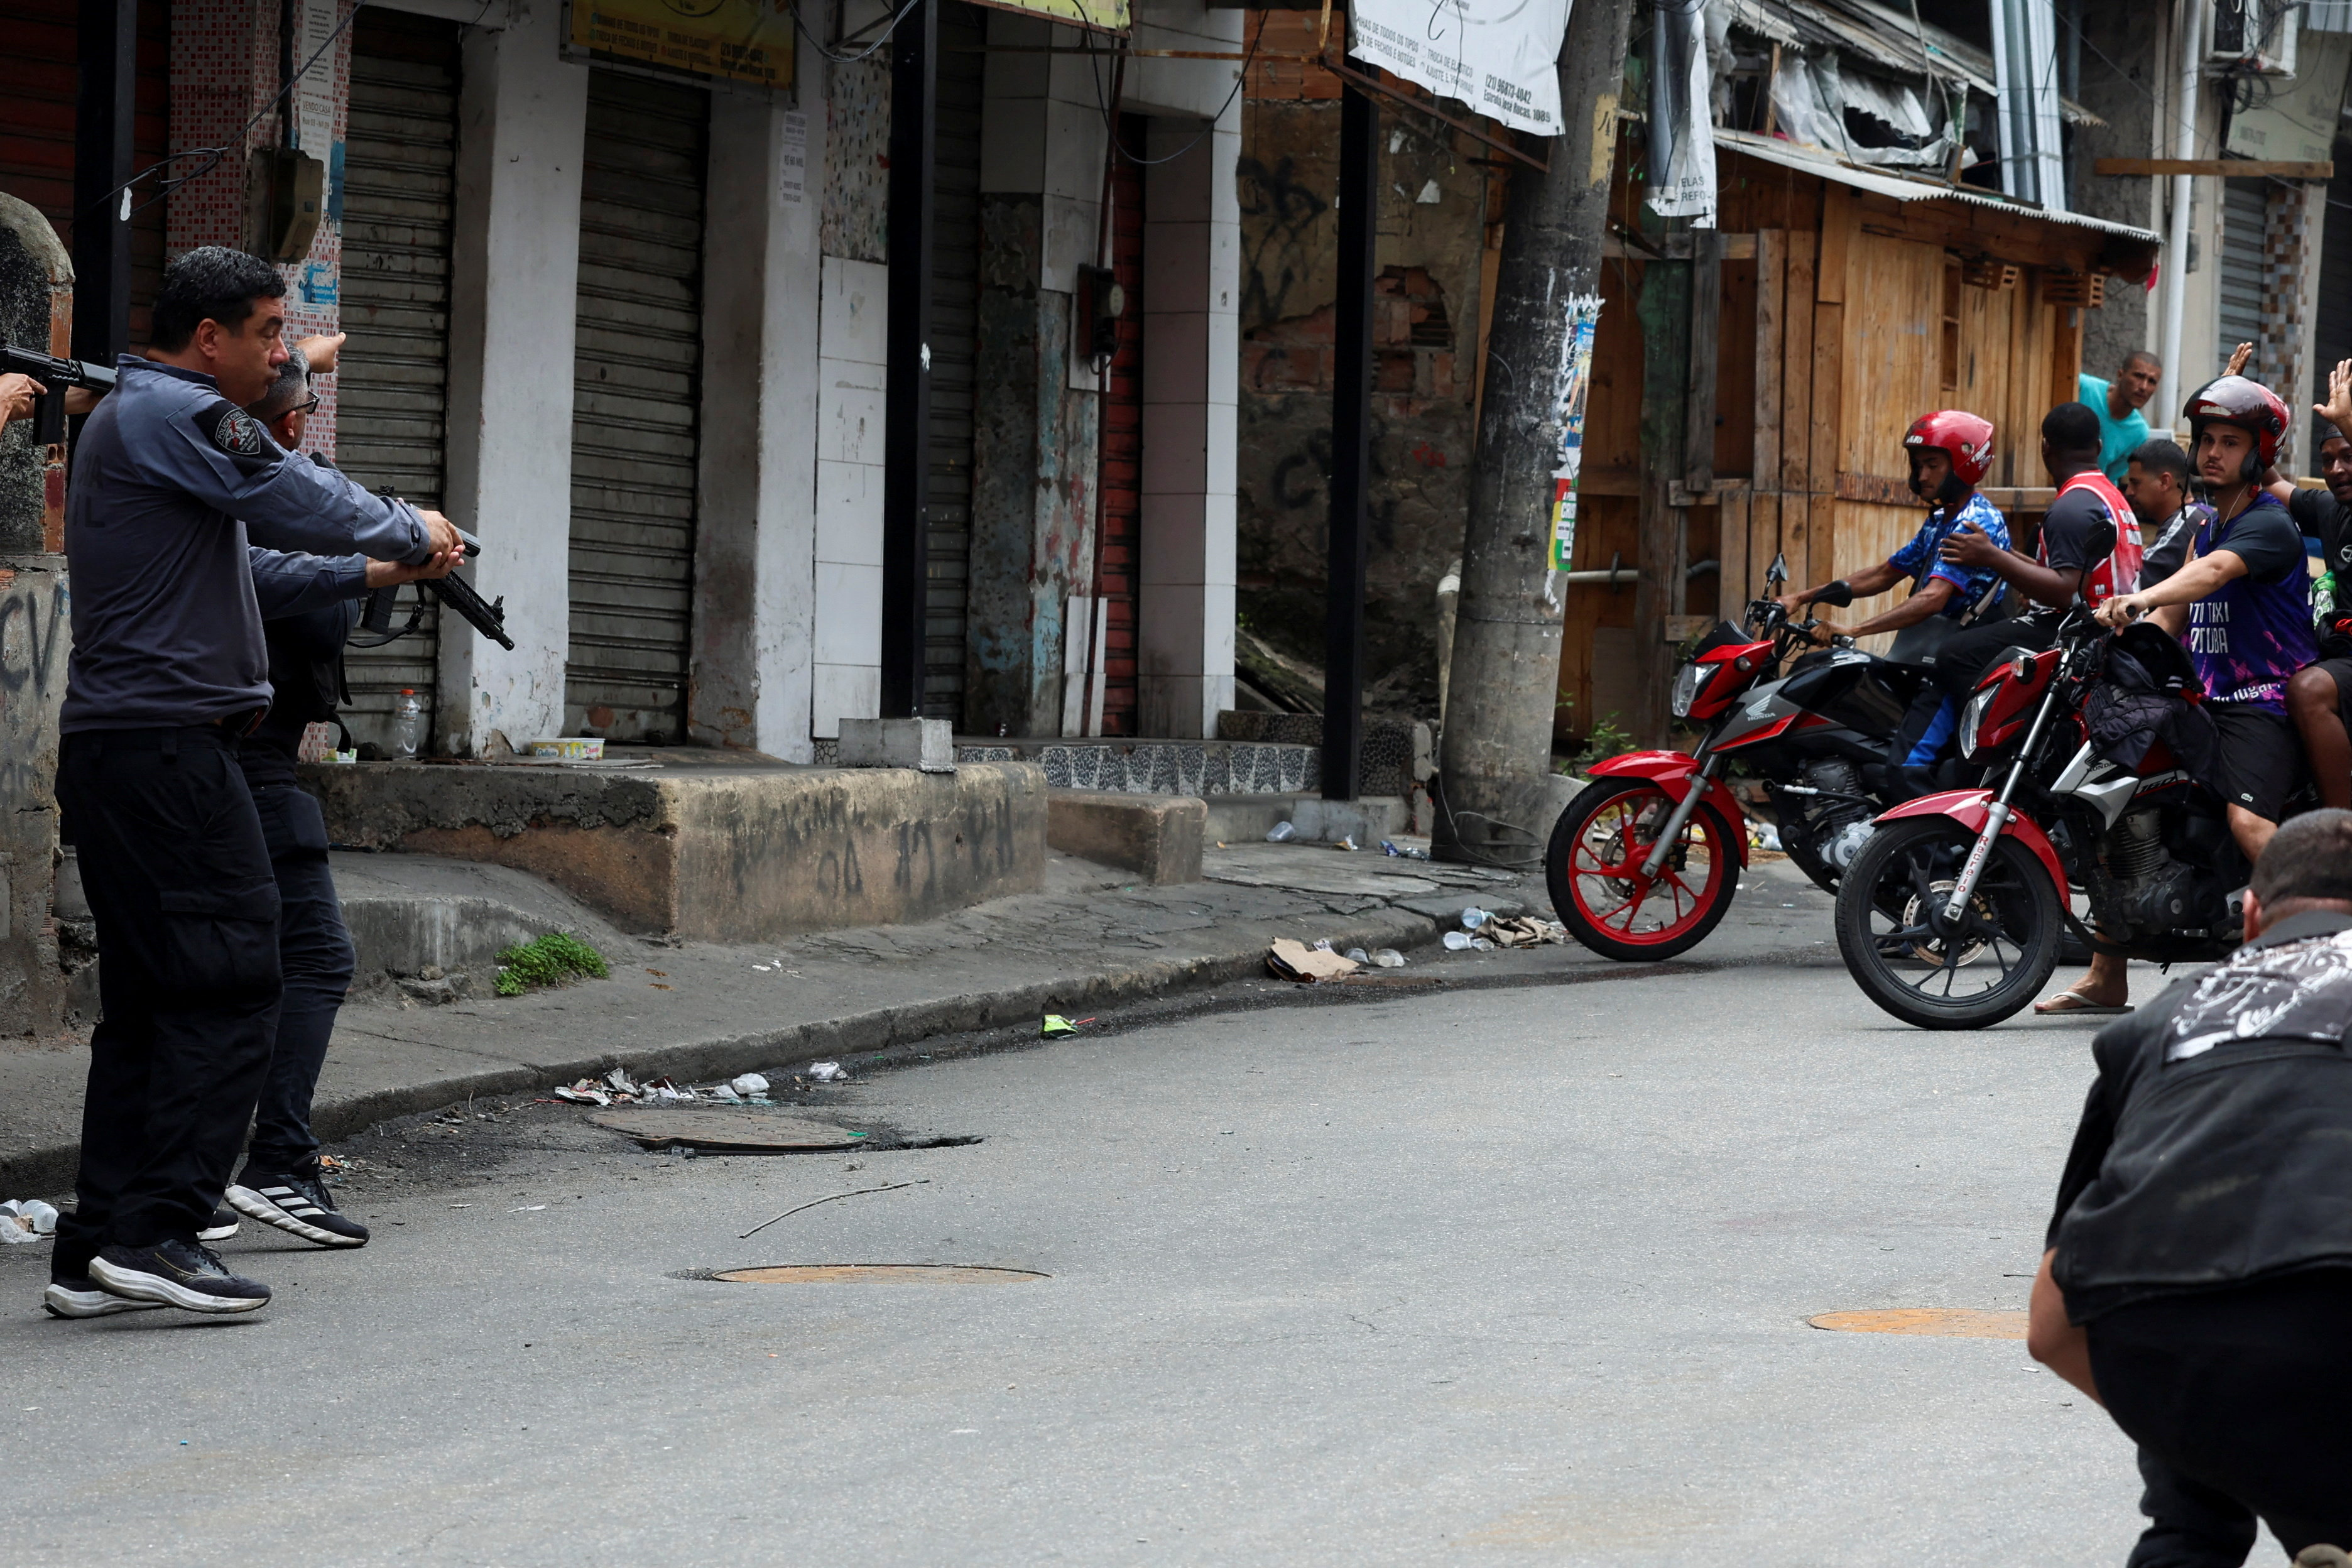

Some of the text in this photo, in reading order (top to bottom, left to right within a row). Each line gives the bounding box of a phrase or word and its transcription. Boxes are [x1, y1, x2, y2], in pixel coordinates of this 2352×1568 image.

[1366, 36, 1373, 48] DE
[1374, 39, 1393, 57] FECHOS
[1393, 49, 1396, 59] E
[1373, 22, 1379, 34] DE
[1380, 25, 1396, 41] TODOS
[1397, 33, 1404, 46] OS
[1405, 36, 1418, 53] TIPOS
[1427, 48, 1443, 63] TROCA
[1443, 55, 1451, 67] DE
[1425, 65, 1444, 82] AJUSTE
[1485, 74, 1532, 104] (21) 96873-4042
[302, 100, 331, 114] VENDO CASA
[1483, 89, 1501, 107] Estrada
[1533, 109, 1550, 123] 1089
[229, 411, 243, 420] CIVIL
[2207, 601, 2230, 623] TAXI
[0, 583, 62, 699] CV
[1747, 712, 1777, 722] HONDA
[1957, 835, 1990, 892] Recreio
